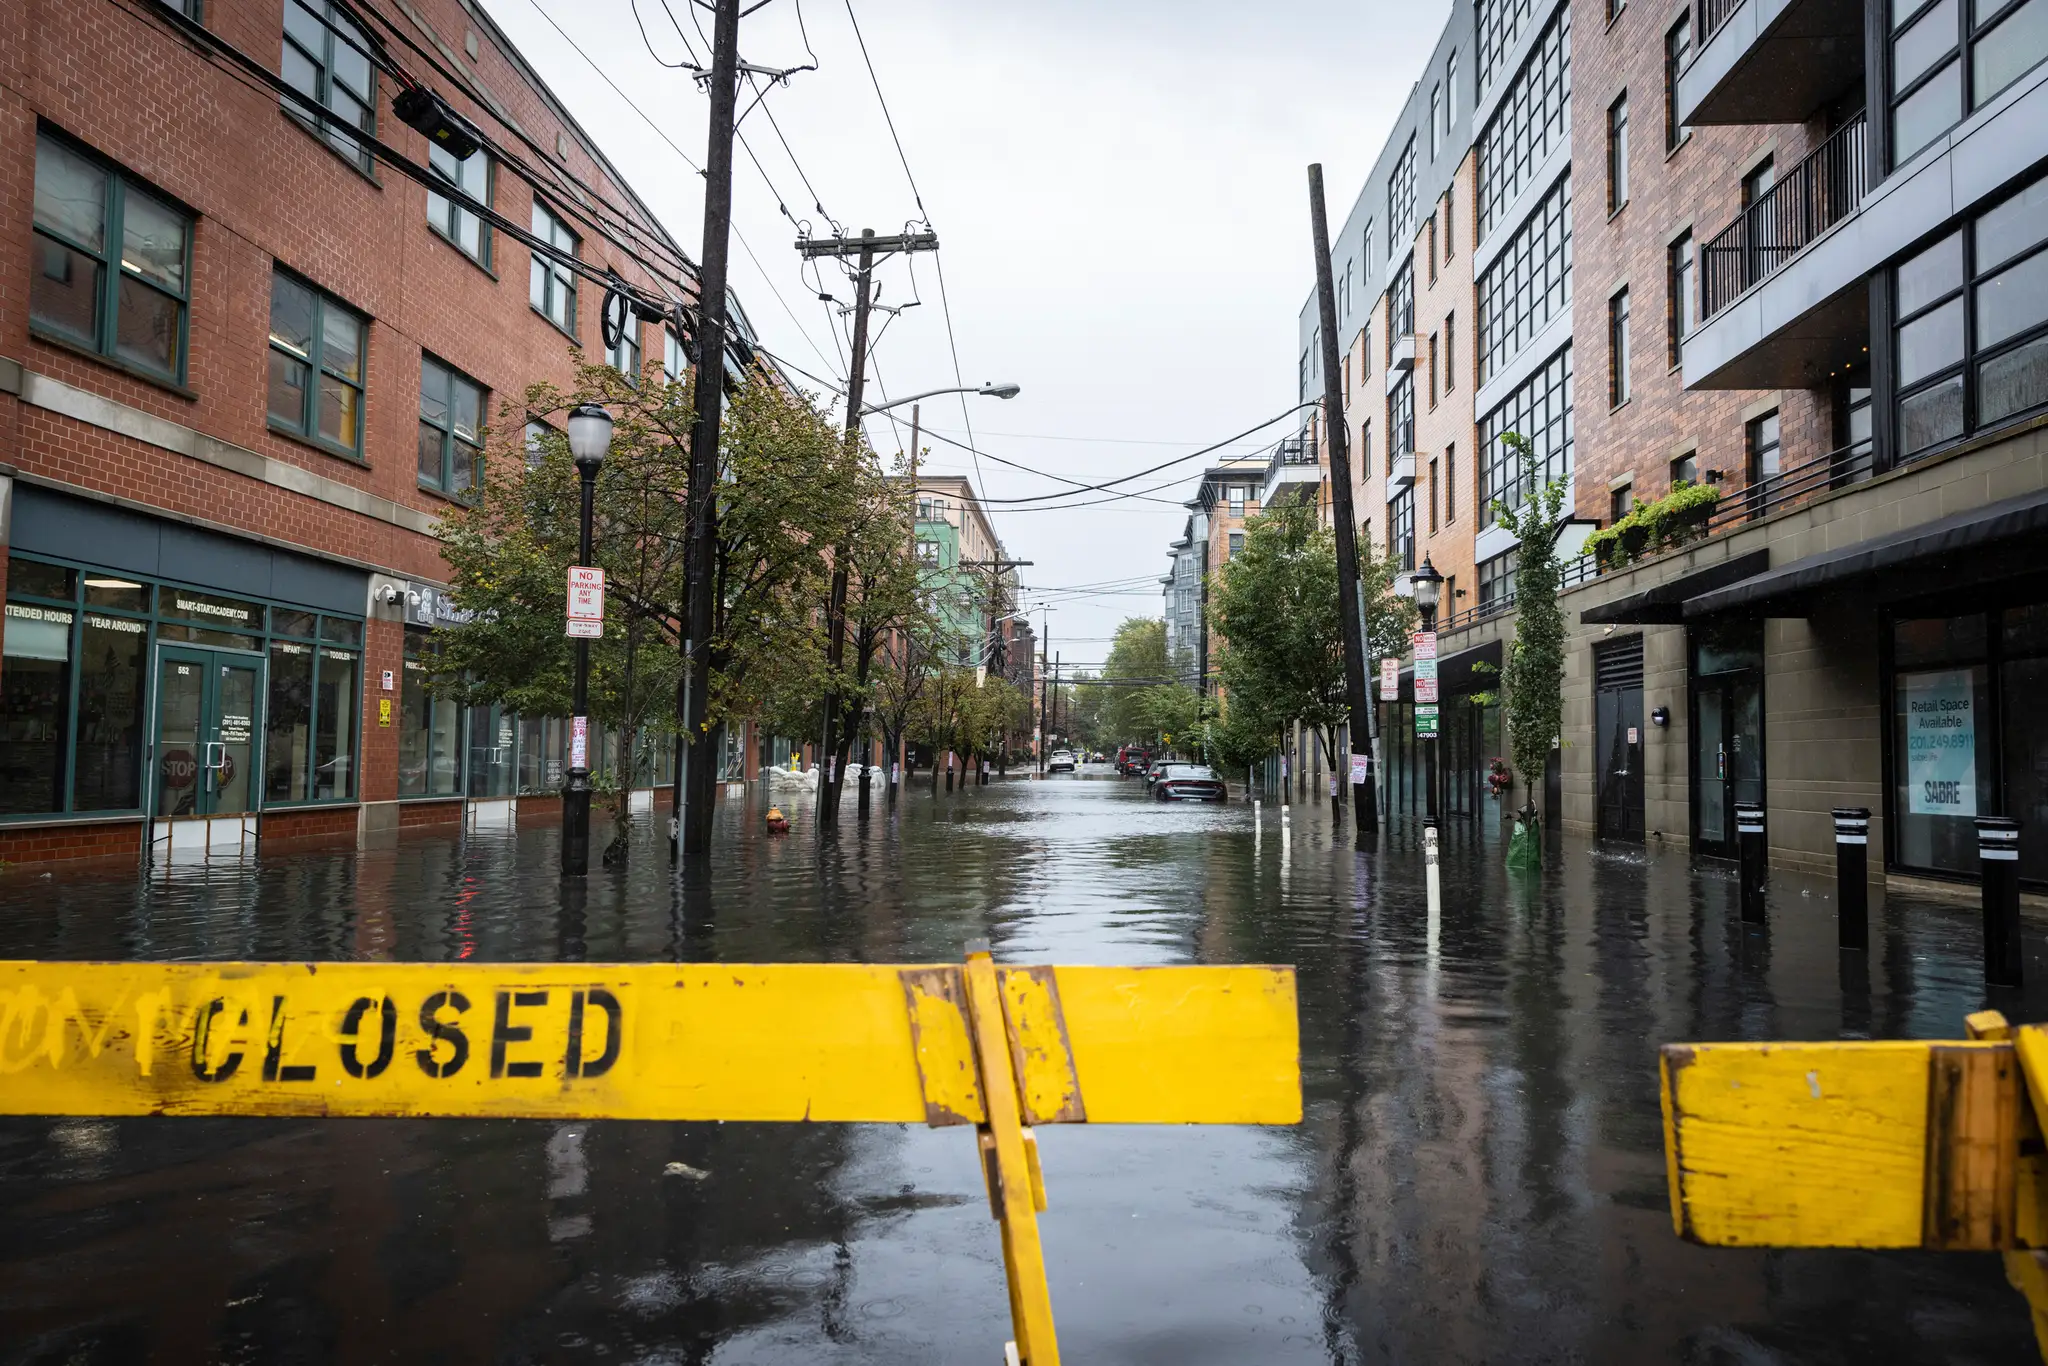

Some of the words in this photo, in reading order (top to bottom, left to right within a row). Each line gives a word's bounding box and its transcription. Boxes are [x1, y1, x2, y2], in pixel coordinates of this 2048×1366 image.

[579, 572, 593, 580] NO
[571, 581, 602, 590] PARKING
[578, 597, 592, 605] TIME
[5, 604, 42, 620] XTENDED
[44, 610, 73, 624] HOURS
[176, 599, 249, 620] SMART-STARTACADEMY.COM
[90, 616, 111, 630] YEAR
[111, 621, 141, 633] AROUND
[282, 644, 301, 655] INFANT
[329, 650, 351, 660] TODDLER
[177, 666, 190, 675] 552
[1416, 680, 1425, 688] NO
[1911, 701, 1938, 713] Retail
[1940, 699, 1970, 715] Space
[1919, 716, 1963, 729] Available
[1924, 779, 1961, 804] SABRE
[191, 987, 622, 1083] CLOSED
